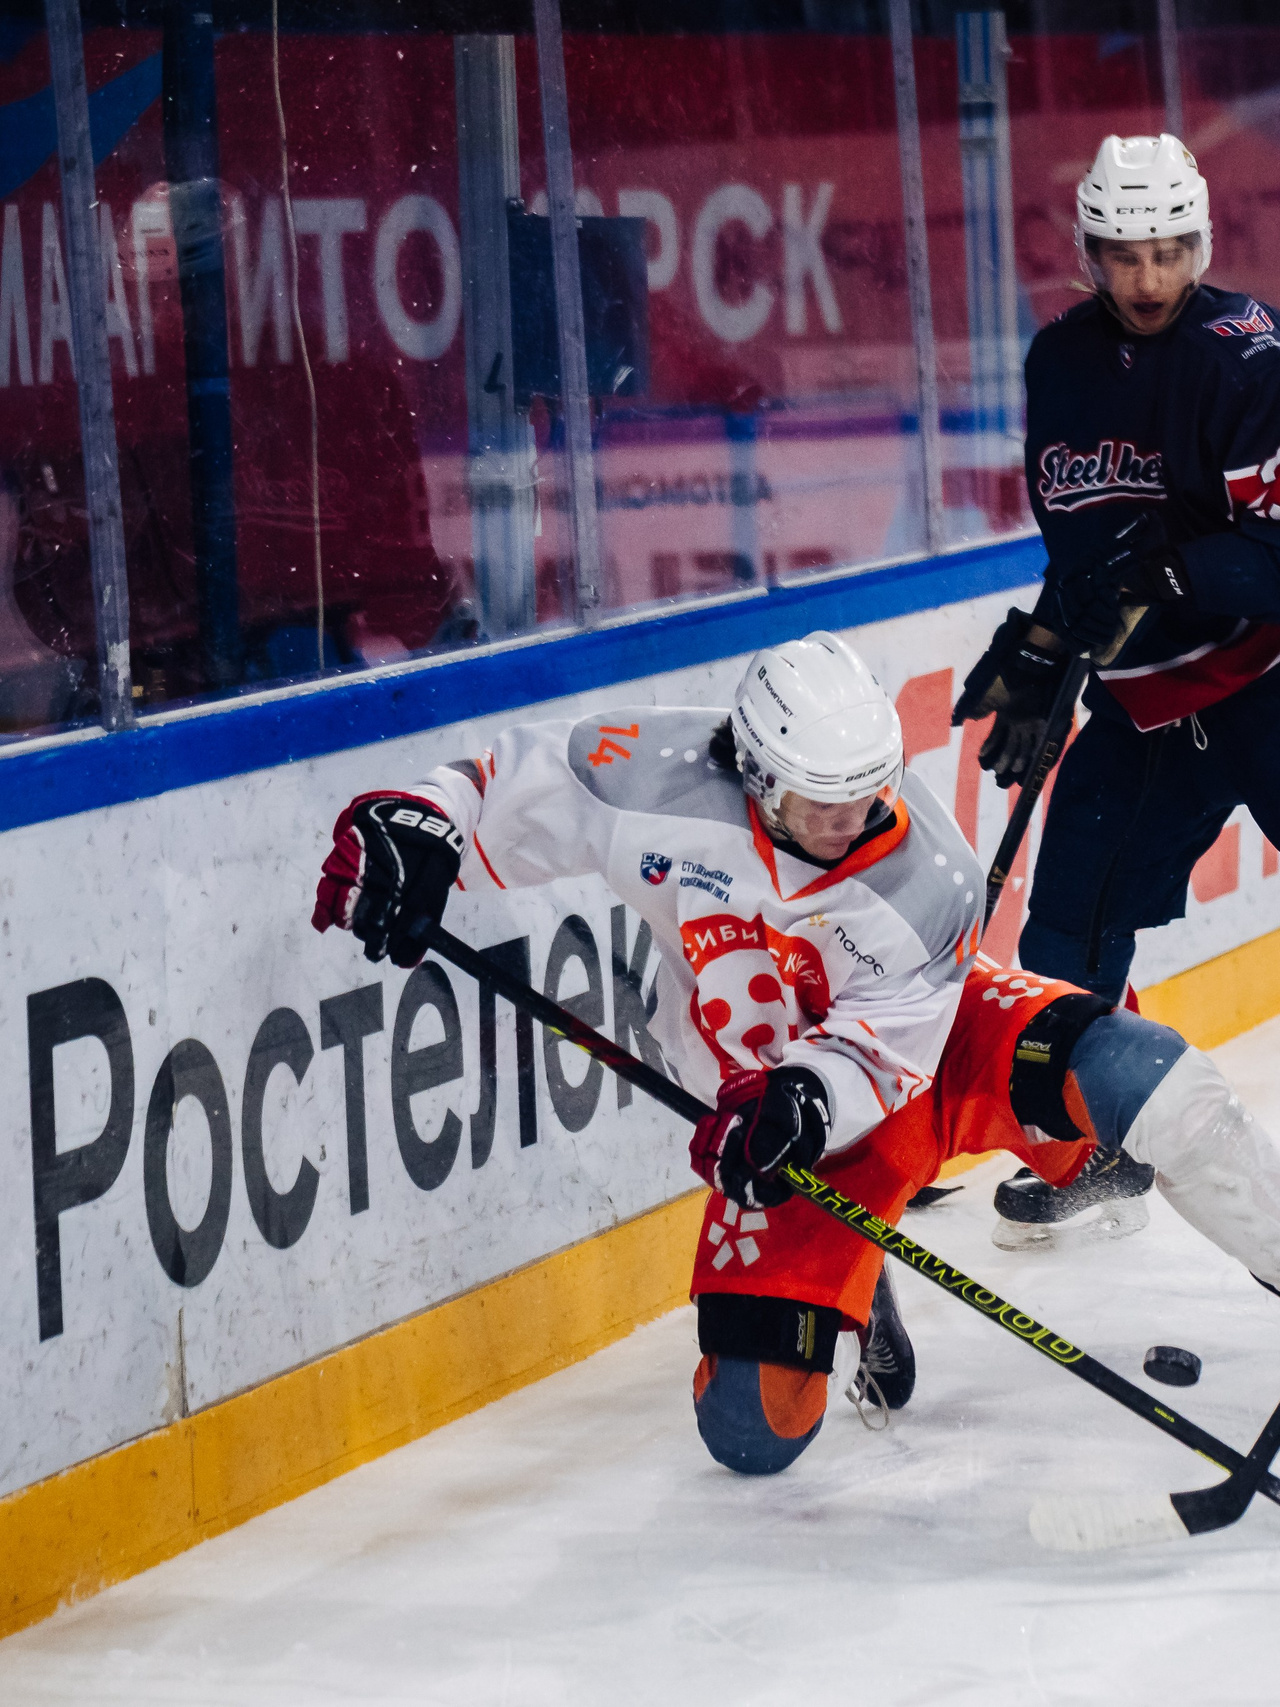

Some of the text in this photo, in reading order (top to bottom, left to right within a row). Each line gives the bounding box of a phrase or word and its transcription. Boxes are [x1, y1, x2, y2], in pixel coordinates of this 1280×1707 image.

[1115, 206, 1158, 215] CCM
[1039, 440, 1114, 498] Steel
[587, 723, 640, 768] 14
[737, 705, 764, 748] BAUER
[844, 762, 888, 783] BAUER
[778, 1161, 1086, 1364] SHERWOOD
